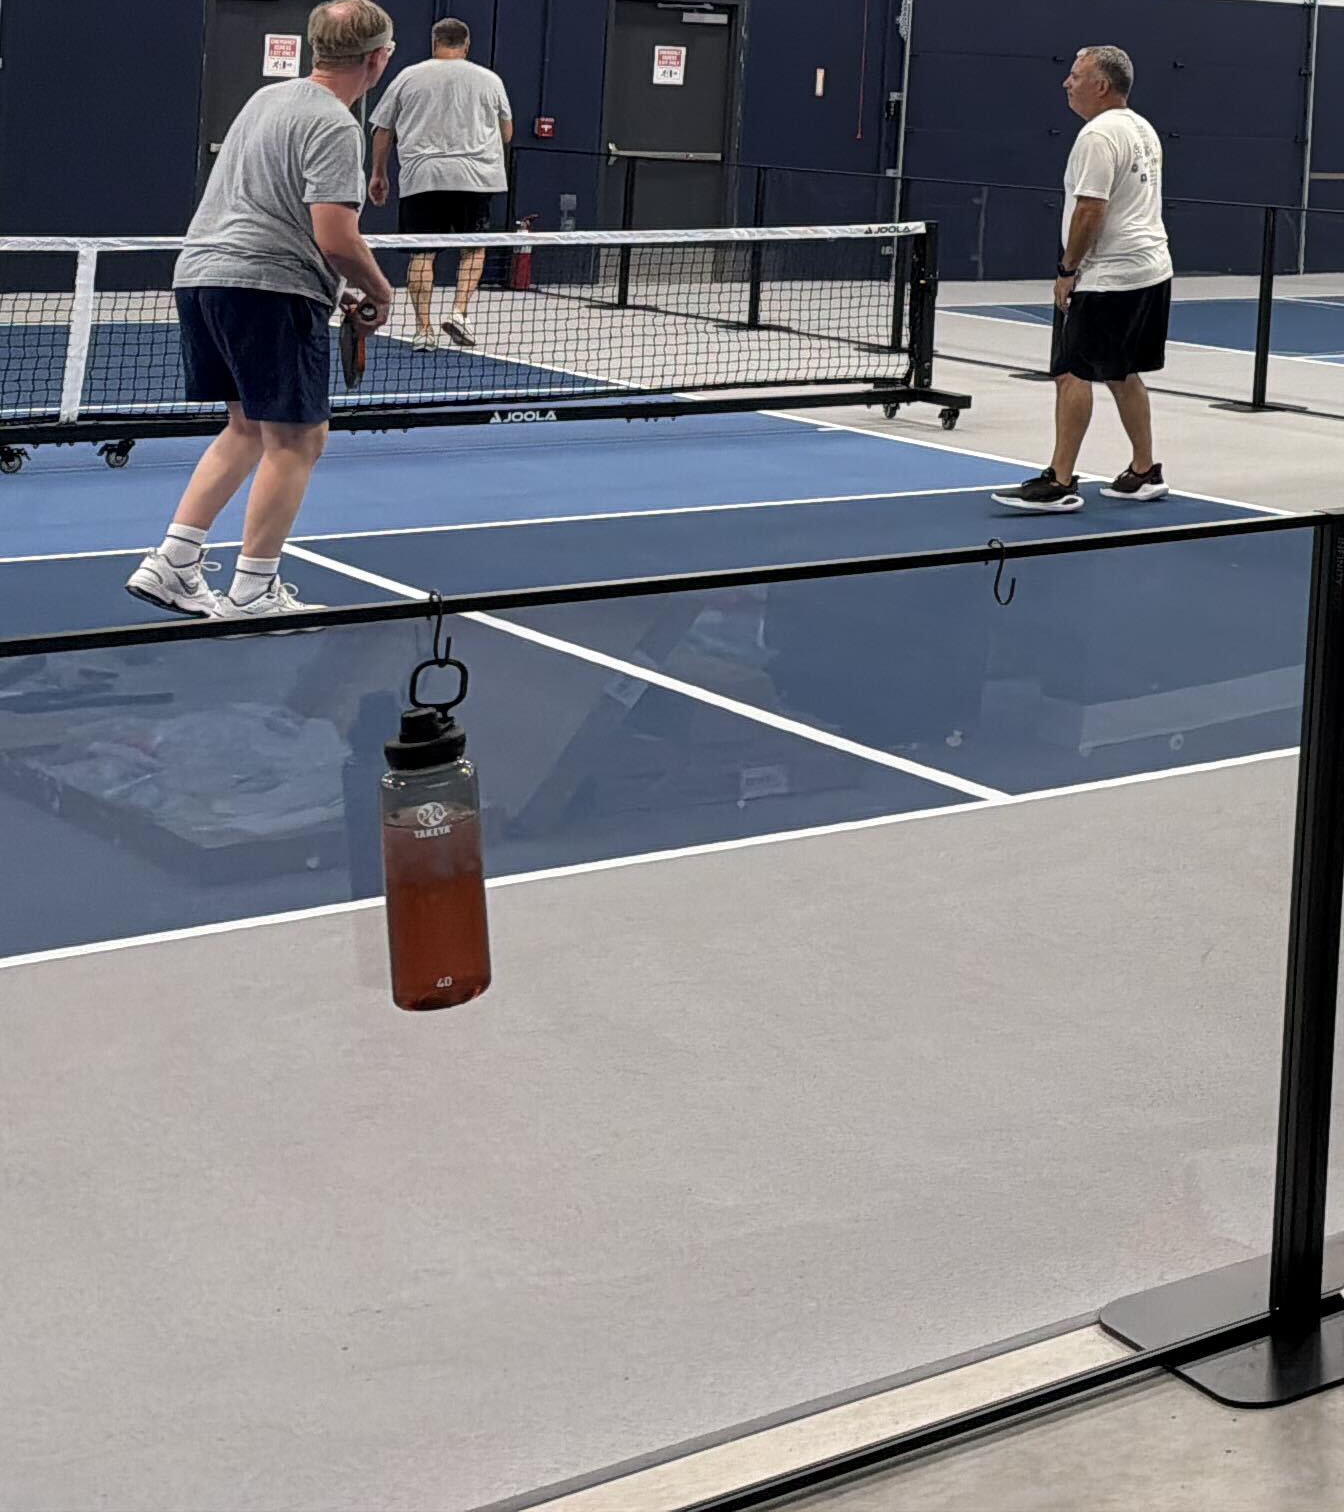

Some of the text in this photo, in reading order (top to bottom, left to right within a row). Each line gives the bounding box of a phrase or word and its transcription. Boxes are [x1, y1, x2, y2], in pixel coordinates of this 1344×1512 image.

[874, 225, 911, 235] JOOLA
[503, 410, 557, 423] JOOLA
[413, 825, 451, 839] TAKEYA
